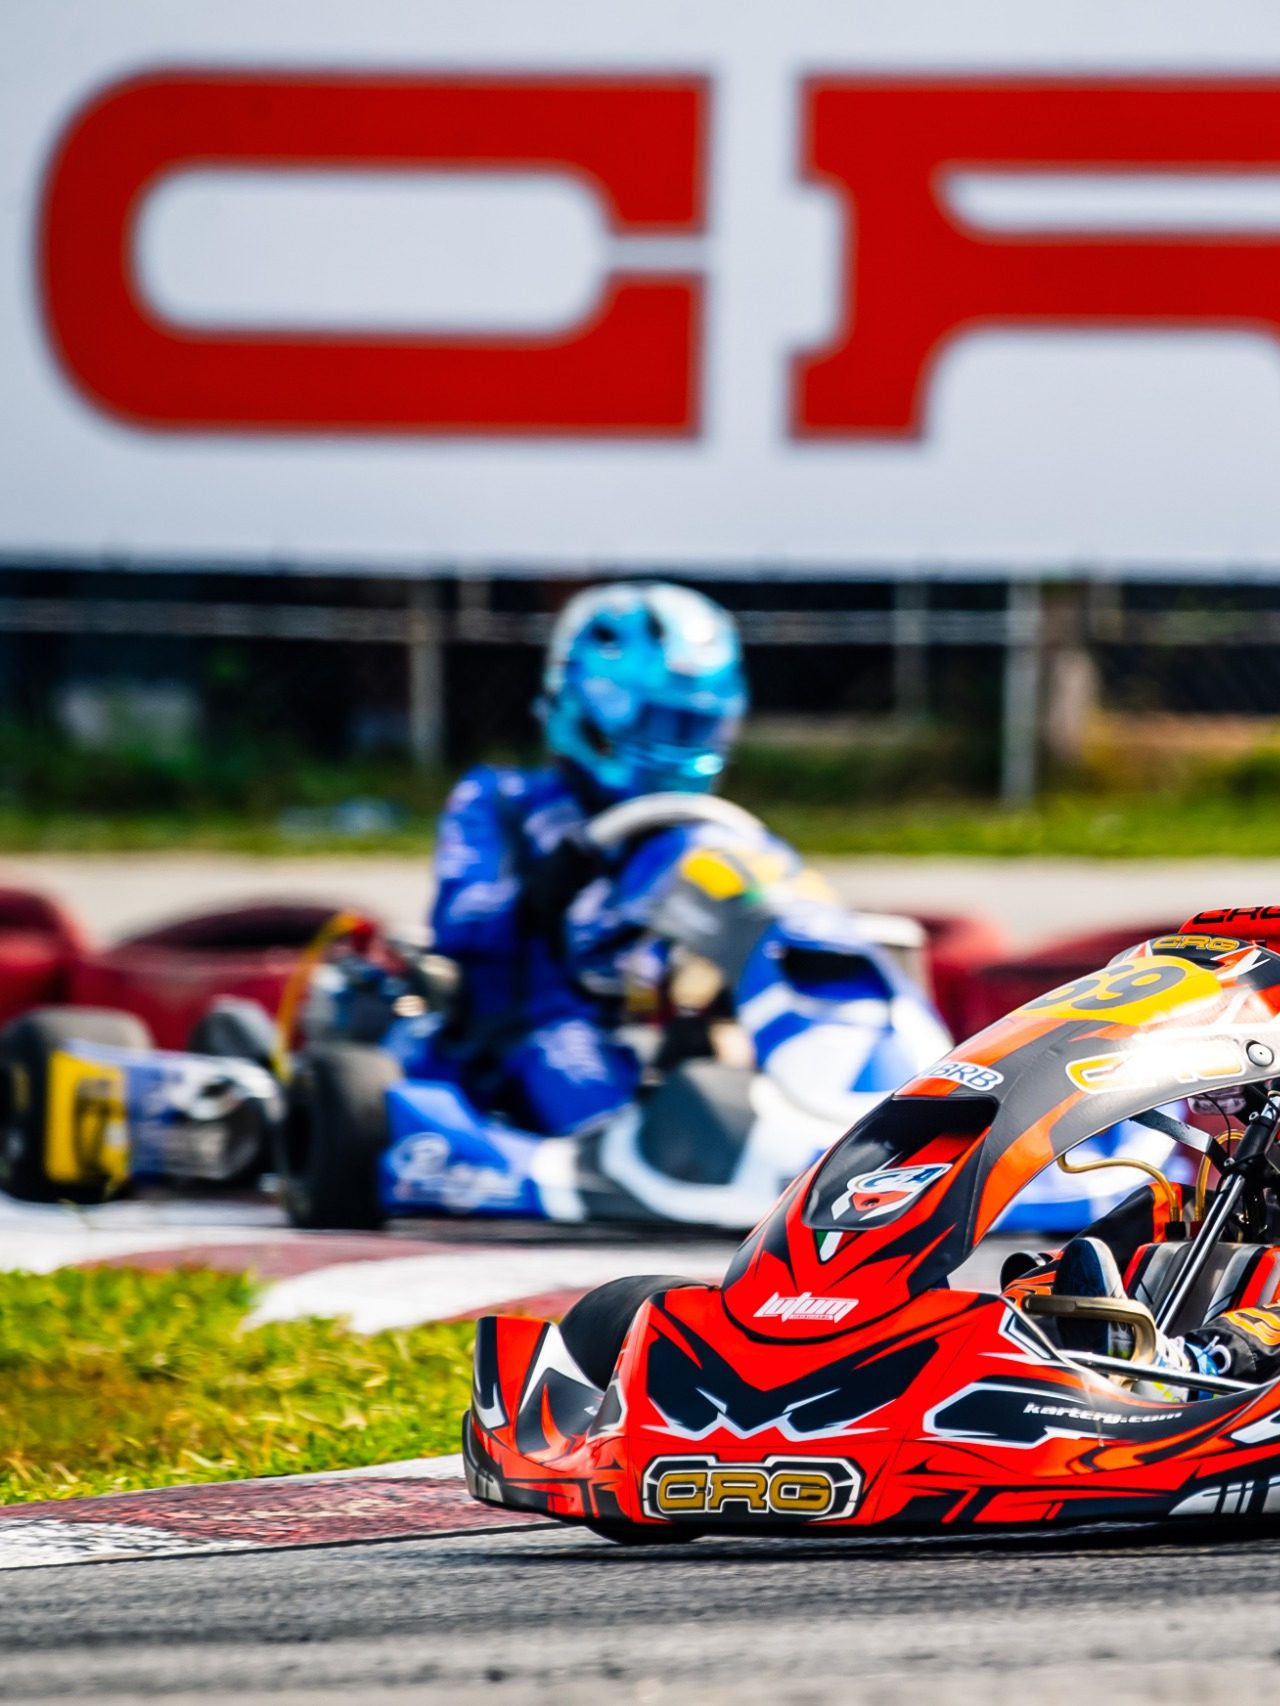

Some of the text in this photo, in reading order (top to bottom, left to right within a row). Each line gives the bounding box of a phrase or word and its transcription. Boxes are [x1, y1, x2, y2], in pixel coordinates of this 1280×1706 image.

[1152, 935, 1240, 952] CRG
[1023, 965, 1187, 1011] 69
[1023, 1402, 1183, 1424] kartcrg.com
[657, 1469, 835, 1514] CRG
